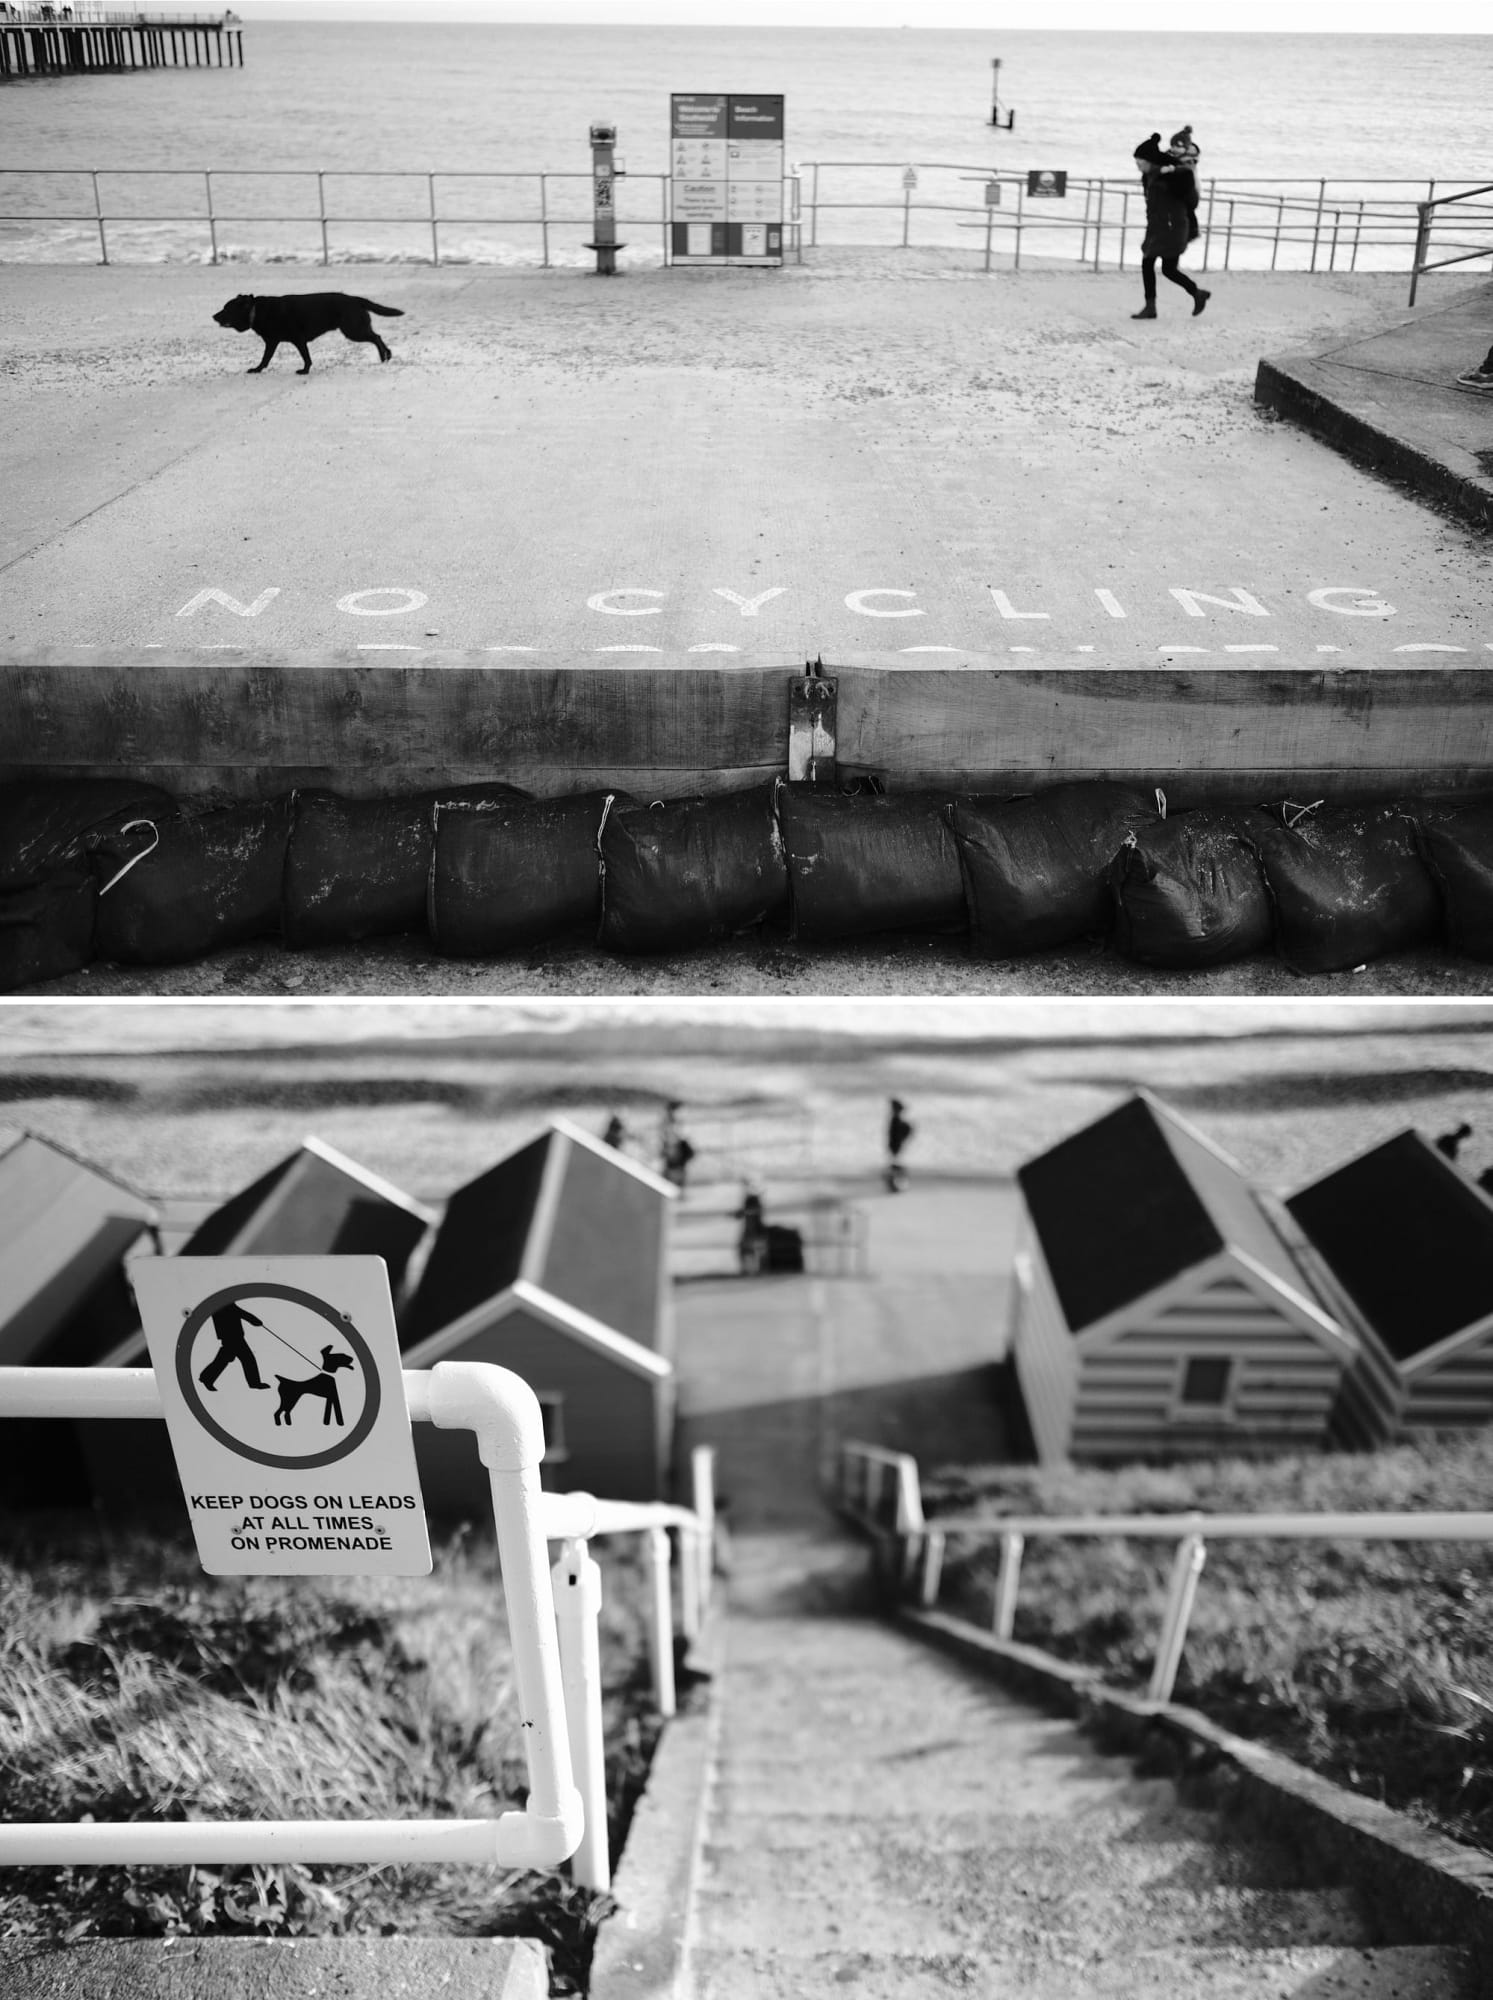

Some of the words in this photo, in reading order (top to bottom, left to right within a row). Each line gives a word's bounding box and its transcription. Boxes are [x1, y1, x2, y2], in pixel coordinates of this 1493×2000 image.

[175, 586, 430, 617] NO
[587, 586, 1399, 619] CYCLING
[190, 1495, 244, 1510] KEEP
[249, 1495, 308, 1510] DOGS
[313, 1495, 343, 1510] ON
[348, 1495, 416, 1510] LEADS
[241, 1516, 265, 1530] AT
[271, 1516, 310, 1530] ALL
[312, 1516, 374, 1530] TIMES
[230, 1536, 260, 1550] ON
[265, 1536, 393, 1550] PROMENADE
